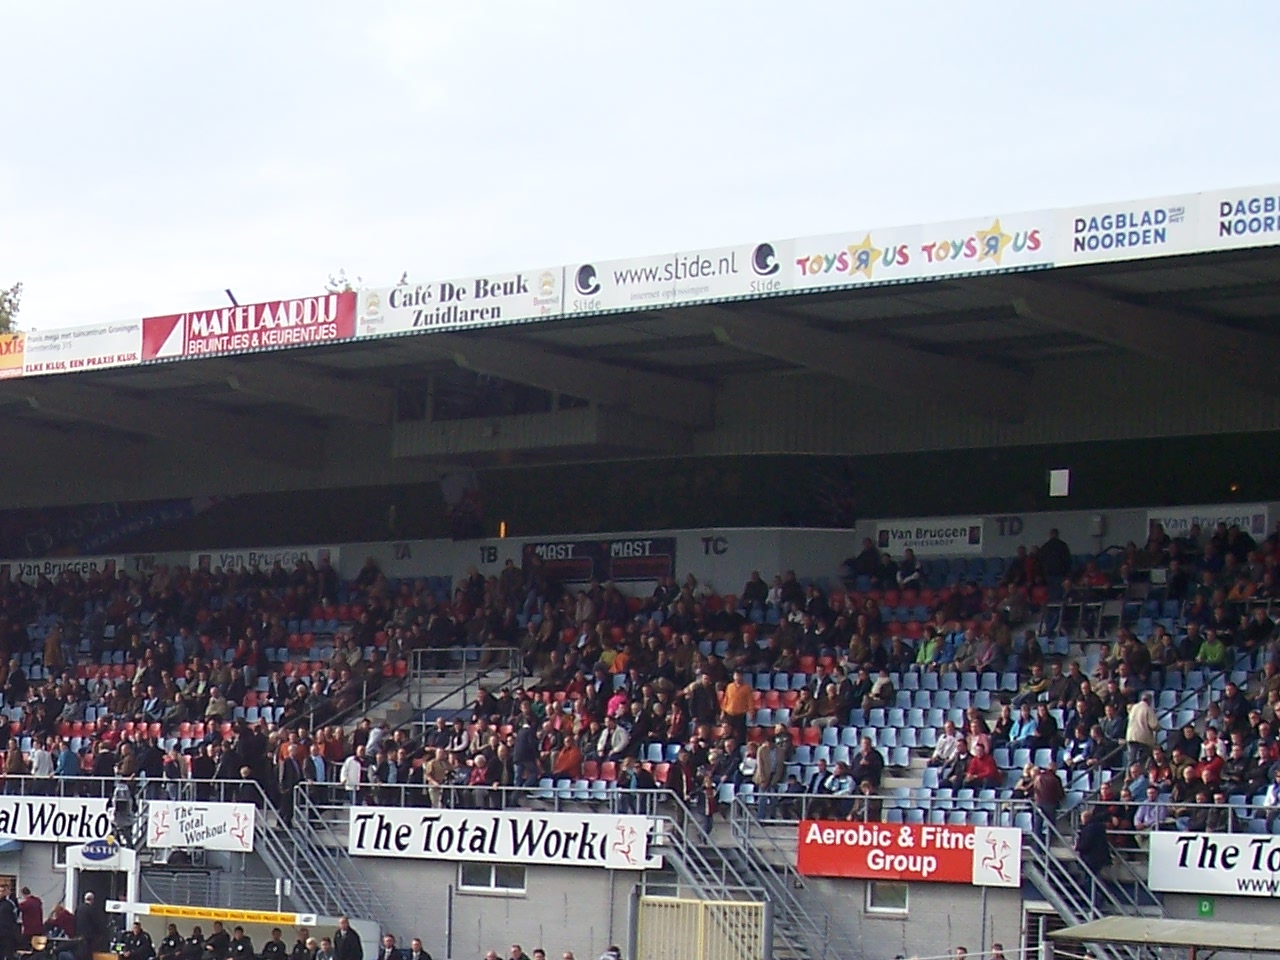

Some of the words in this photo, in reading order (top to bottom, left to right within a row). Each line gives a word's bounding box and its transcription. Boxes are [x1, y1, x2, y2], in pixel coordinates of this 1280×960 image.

[1074, 209, 1167, 234] DAGBLAD
[921, 237, 977, 263] TOYS
[1012, 229, 1042, 252] US
[1073, 228, 1167, 252] NOORDEN
[613, 252, 739, 286] www.slide.nl
[796, 251, 849, 275] TOYS
[882, 244, 910, 267] US
[388, 284, 433, 309] Café
[439, 282, 467, 303] De
[474, 274, 529, 300] Beuk
[750, 279, 781, 293] Slide
[190, 294, 338, 338] MAKELAARDIJ
[573, 299, 602, 311] Slide
[412, 306, 502, 328] Zuidlaren
[188, 332, 250, 355] BRUINTJES
[251, 336, 260, 347] &
[261, 323, 338, 344] KEURENTJES
[25, 363, 44, 373] ELKE
[69, 359, 84, 369] EEN
[86, 355, 115, 367] PRAXIS
[890, 528, 913, 540] Van
[915, 527, 967, 539] Bruggen
[997, 516, 1024, 537] TD
[479, 545, 499, 565] TB
[610, 540, 652, 556] MAST
[701, 535, 729, 555] TC
[19, 563, 41, 576] Van
[219, 551, 244, 567] Van
[174, 806, 193, 820] The
[179, 814, 204, 833] Total
[185, 822, 227, 844] Workout
[355, 811, 412, 852] The
[420, 814, 501, 855] Total
[805, 822, 892, 847] Aerobic
[897, 826, 915, 847] &
[866, 849, 937, 878] Group
[1176, 834, 1240, 871] The
[1201, 901, 1210, 912] D
